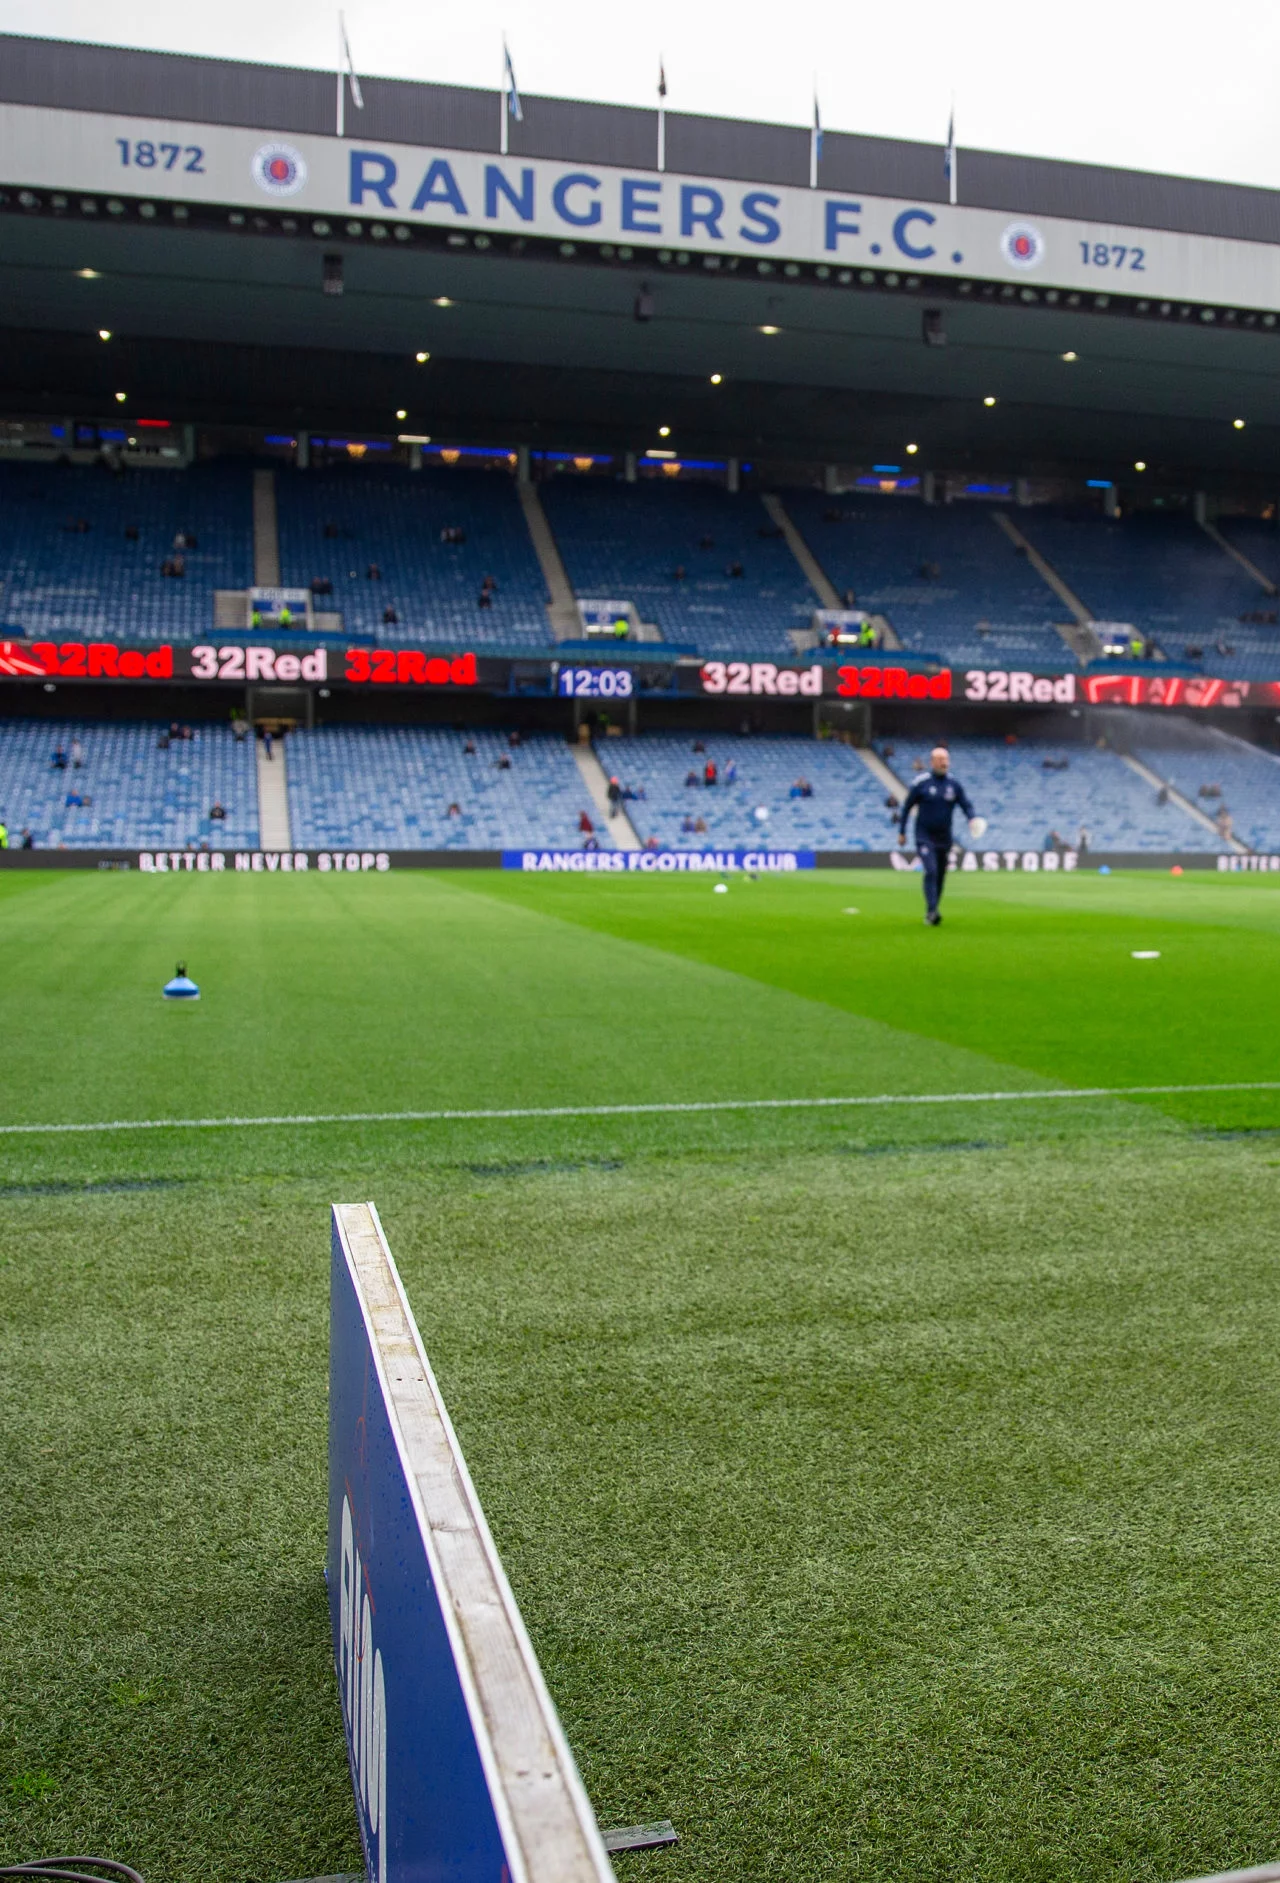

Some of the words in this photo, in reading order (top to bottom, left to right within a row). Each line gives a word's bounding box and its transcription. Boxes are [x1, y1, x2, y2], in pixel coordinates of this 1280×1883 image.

[117, 138, 205, 173] 1872
[349, 150, 783, 245] RANGERS
[824, 200, 965, 264] F.C.
[1080, 240, 1146, 272] 1872
[32, 642, 174, 680] 32Red
[191, 645, 328, 681] 32Red
[344, 648, 478, 686] 32Red
[560, 669, 633, 697] 12:03
[701, 661, 824, 696] 32Red
[836, 666, 953, 700] 32Red
[964, 670, 1076, 704] 32Red
[138, 852, 226, 873] BETTER
[235, 852, 309, 873] NEVER
[317, 852, 390, 872] STOPS
[522, 852, 624, 872] RANGERS
[628, 852, 739, 872] FOOTBALL
[743, 852, 798, 872] CLUB
[1216, 855, 1280, 873] BETTER
